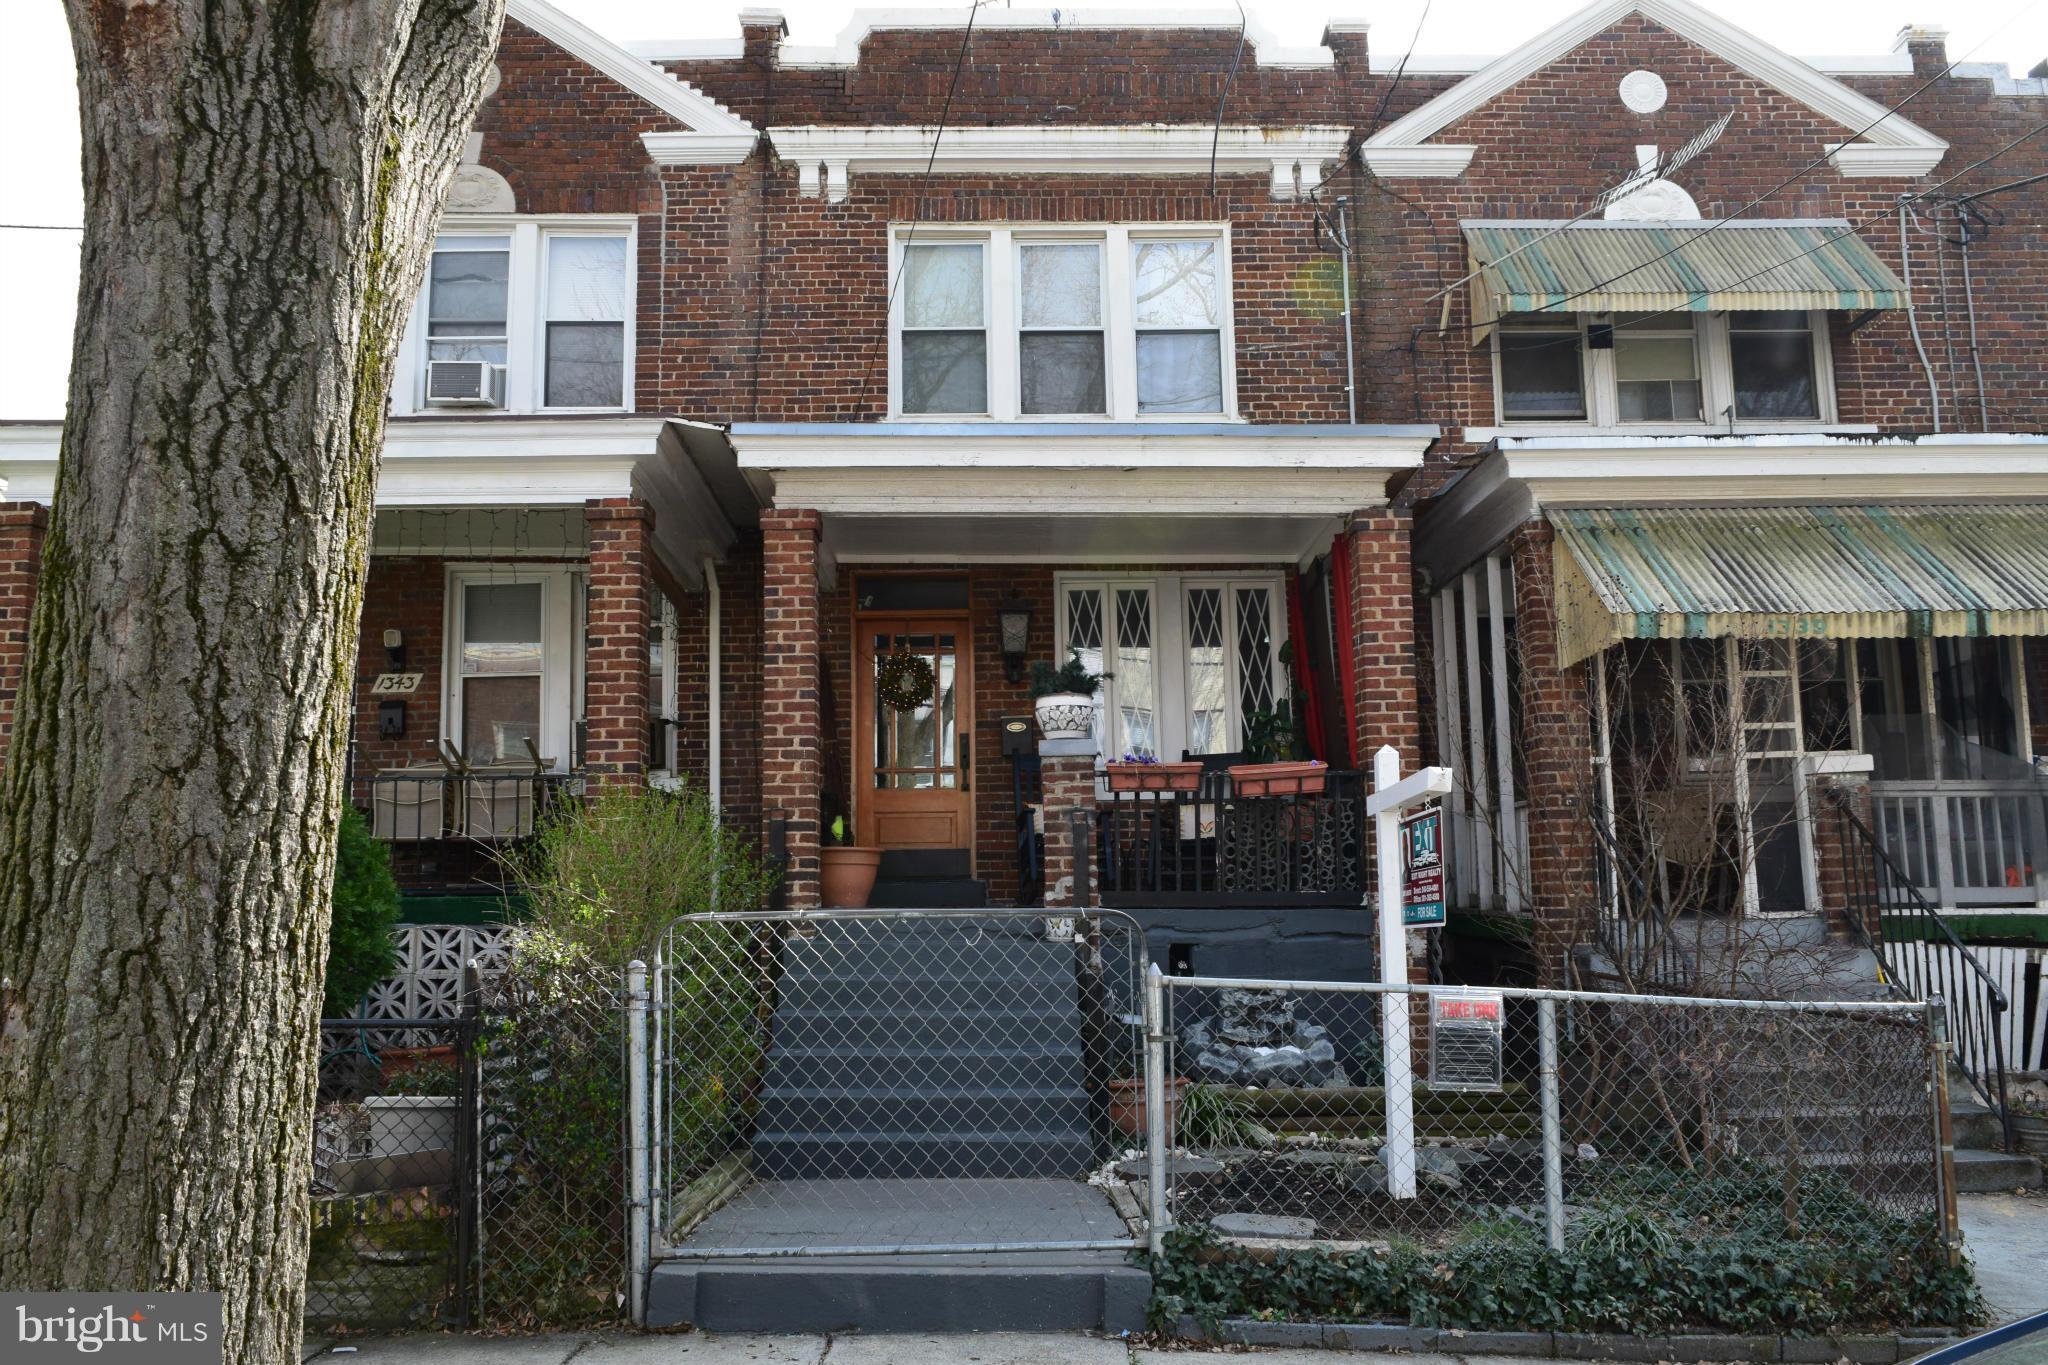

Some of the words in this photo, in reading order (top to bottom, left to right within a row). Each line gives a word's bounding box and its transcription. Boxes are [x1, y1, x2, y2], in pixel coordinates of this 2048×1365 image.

[377, 676, 415, 691] 1343
[1412, 815, 1438, 858] EXIT
[1417, 907, 1426, 919] FOR
[1426, 905, 1437, 918] SALE
[1440, 1001, 1470, 1018] TAKE
